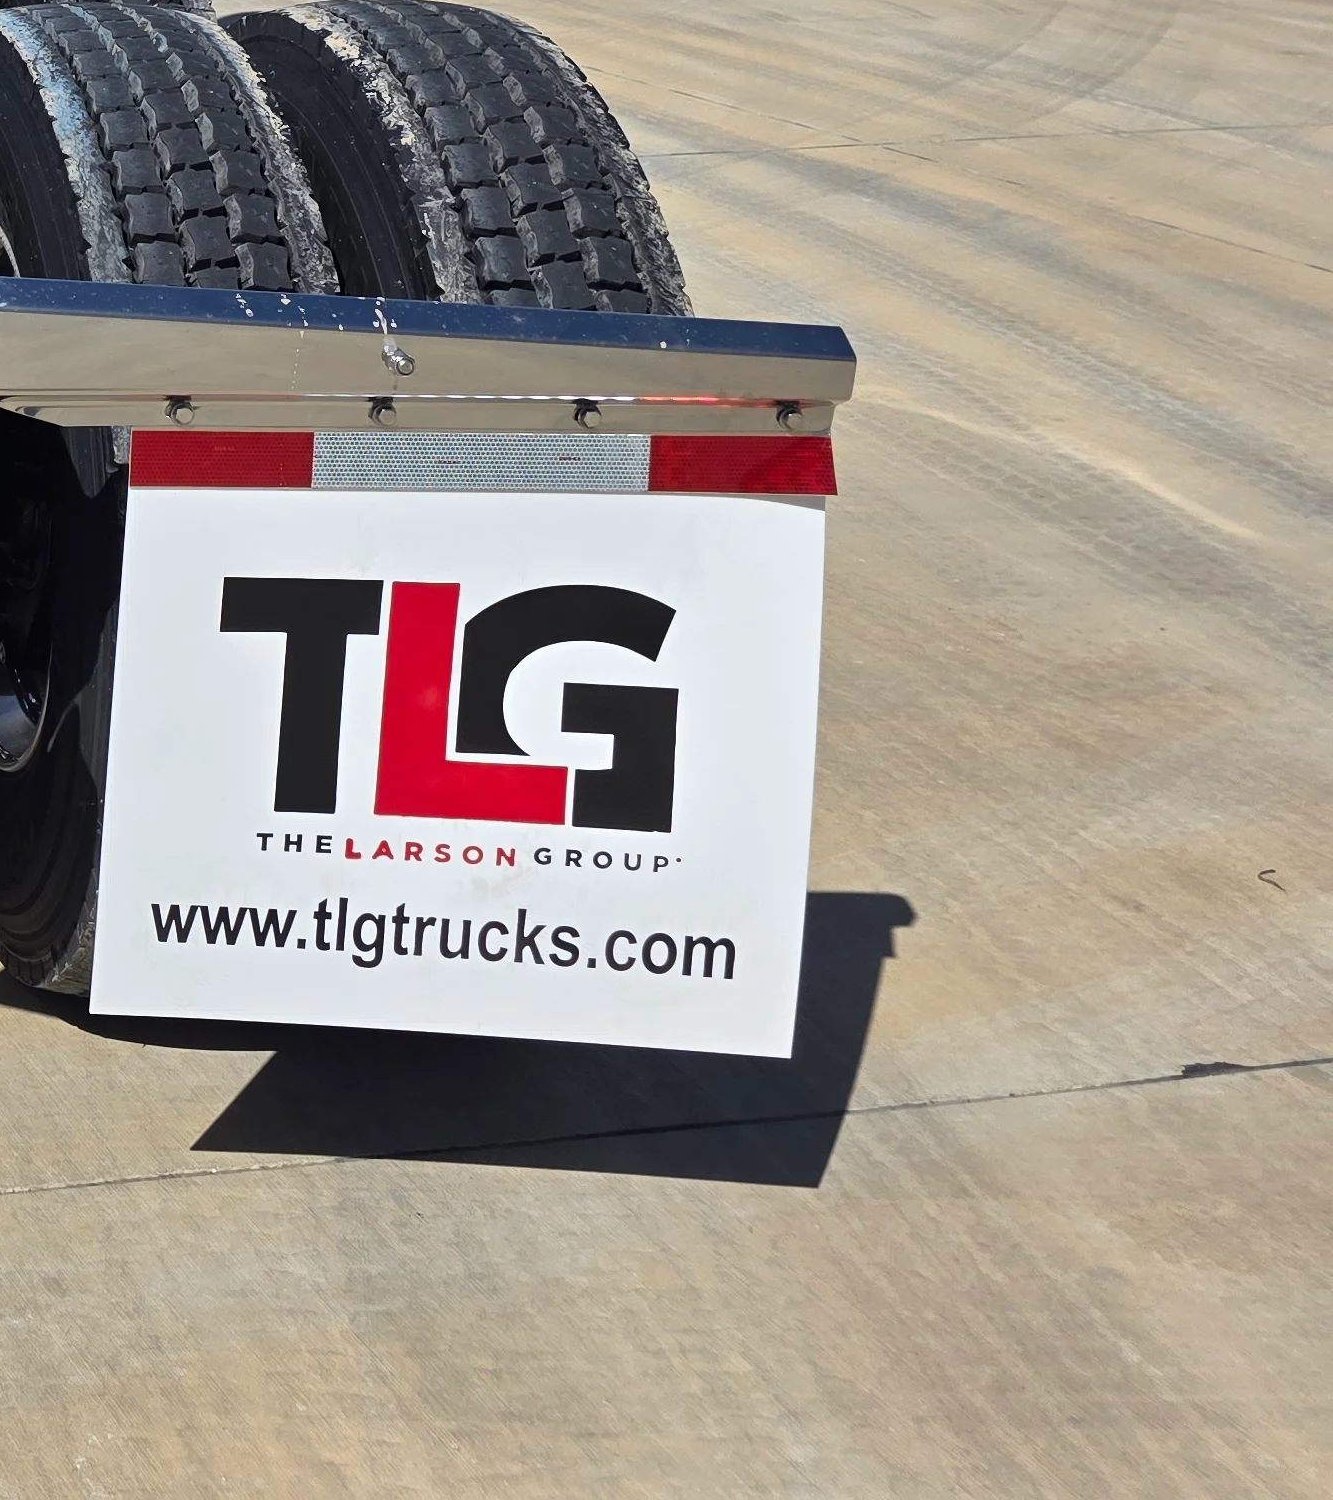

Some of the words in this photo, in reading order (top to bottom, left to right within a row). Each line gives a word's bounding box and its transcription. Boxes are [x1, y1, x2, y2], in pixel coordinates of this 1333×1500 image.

[219, 576, 680, 834] TLG
[533, 847, 670, 873] GROUP
[150, 897, 736, 980] www.tlgtrucks.com
